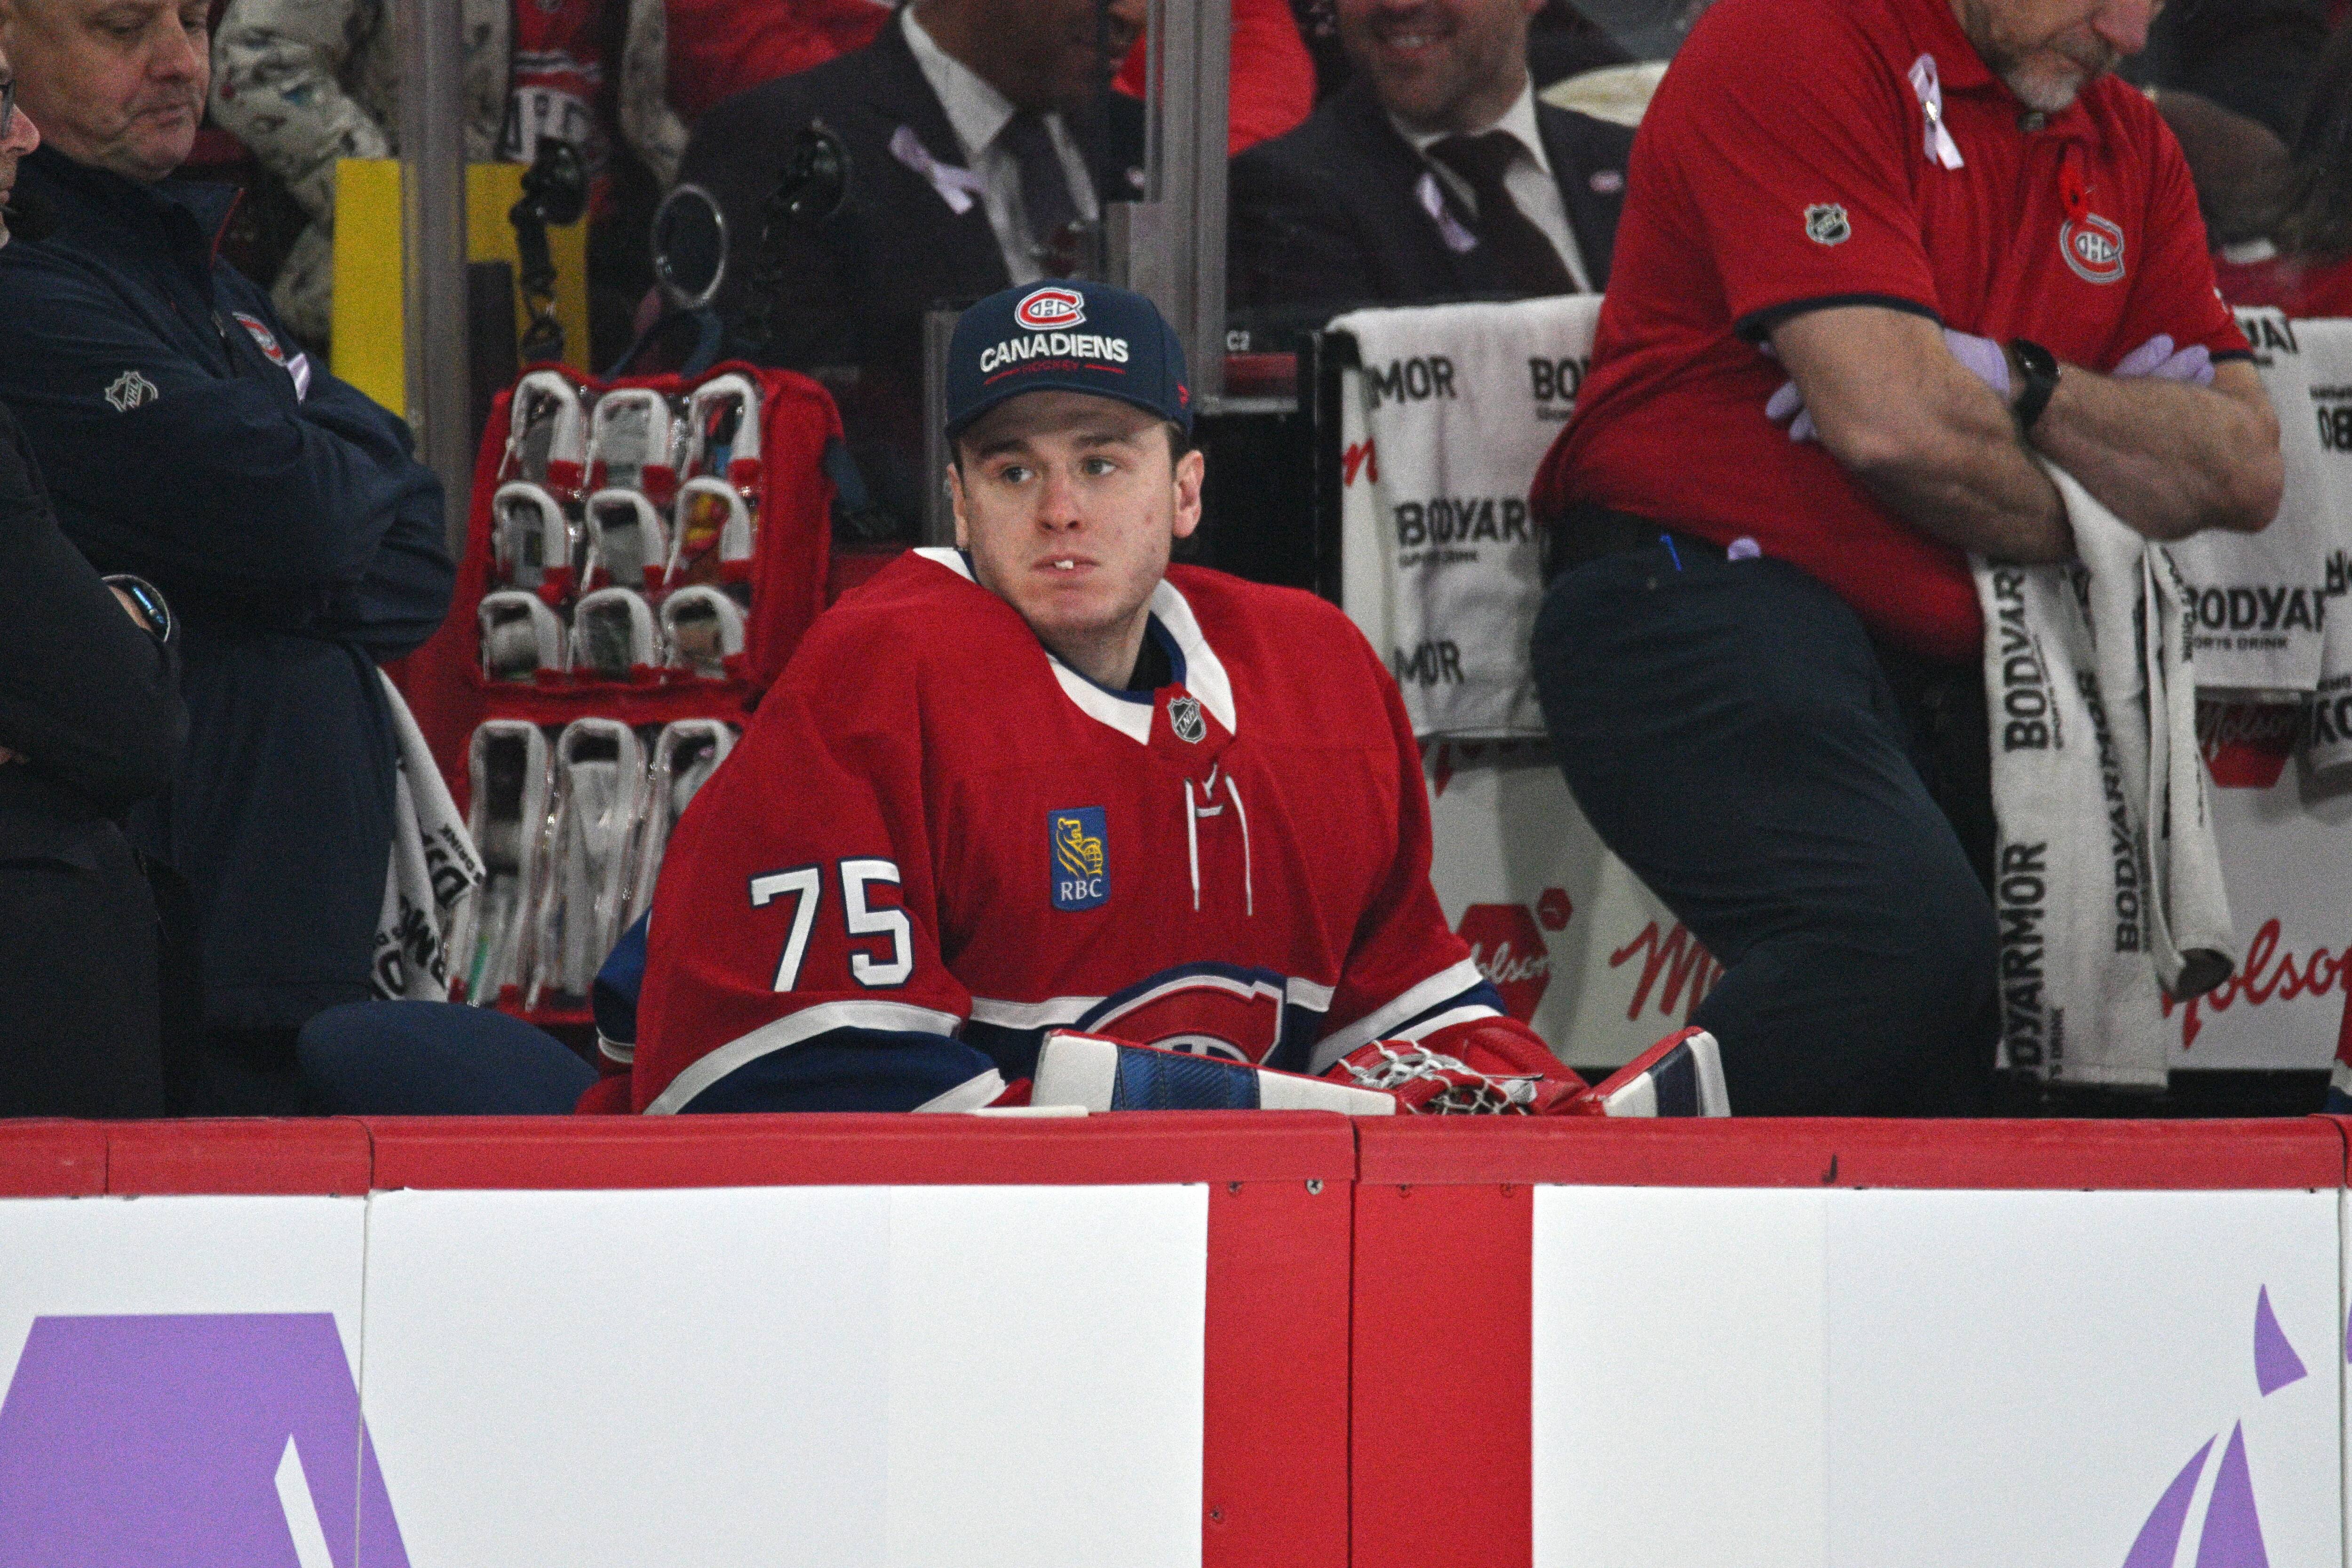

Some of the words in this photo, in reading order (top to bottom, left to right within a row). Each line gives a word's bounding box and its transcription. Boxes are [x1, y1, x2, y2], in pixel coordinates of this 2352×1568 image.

[980, 333, 1129, 373] CANADIENS
[1529, 357, 1591, 401] BO
[1993, 570, 2049, 752] BODYAR
[2236, 636, 2288, 650] DRINK
[2076, 669, 2139, 954] BODYARMOR
[1060, 878, 1103, 902] RBC
[750, 857, 914, 992] 75
